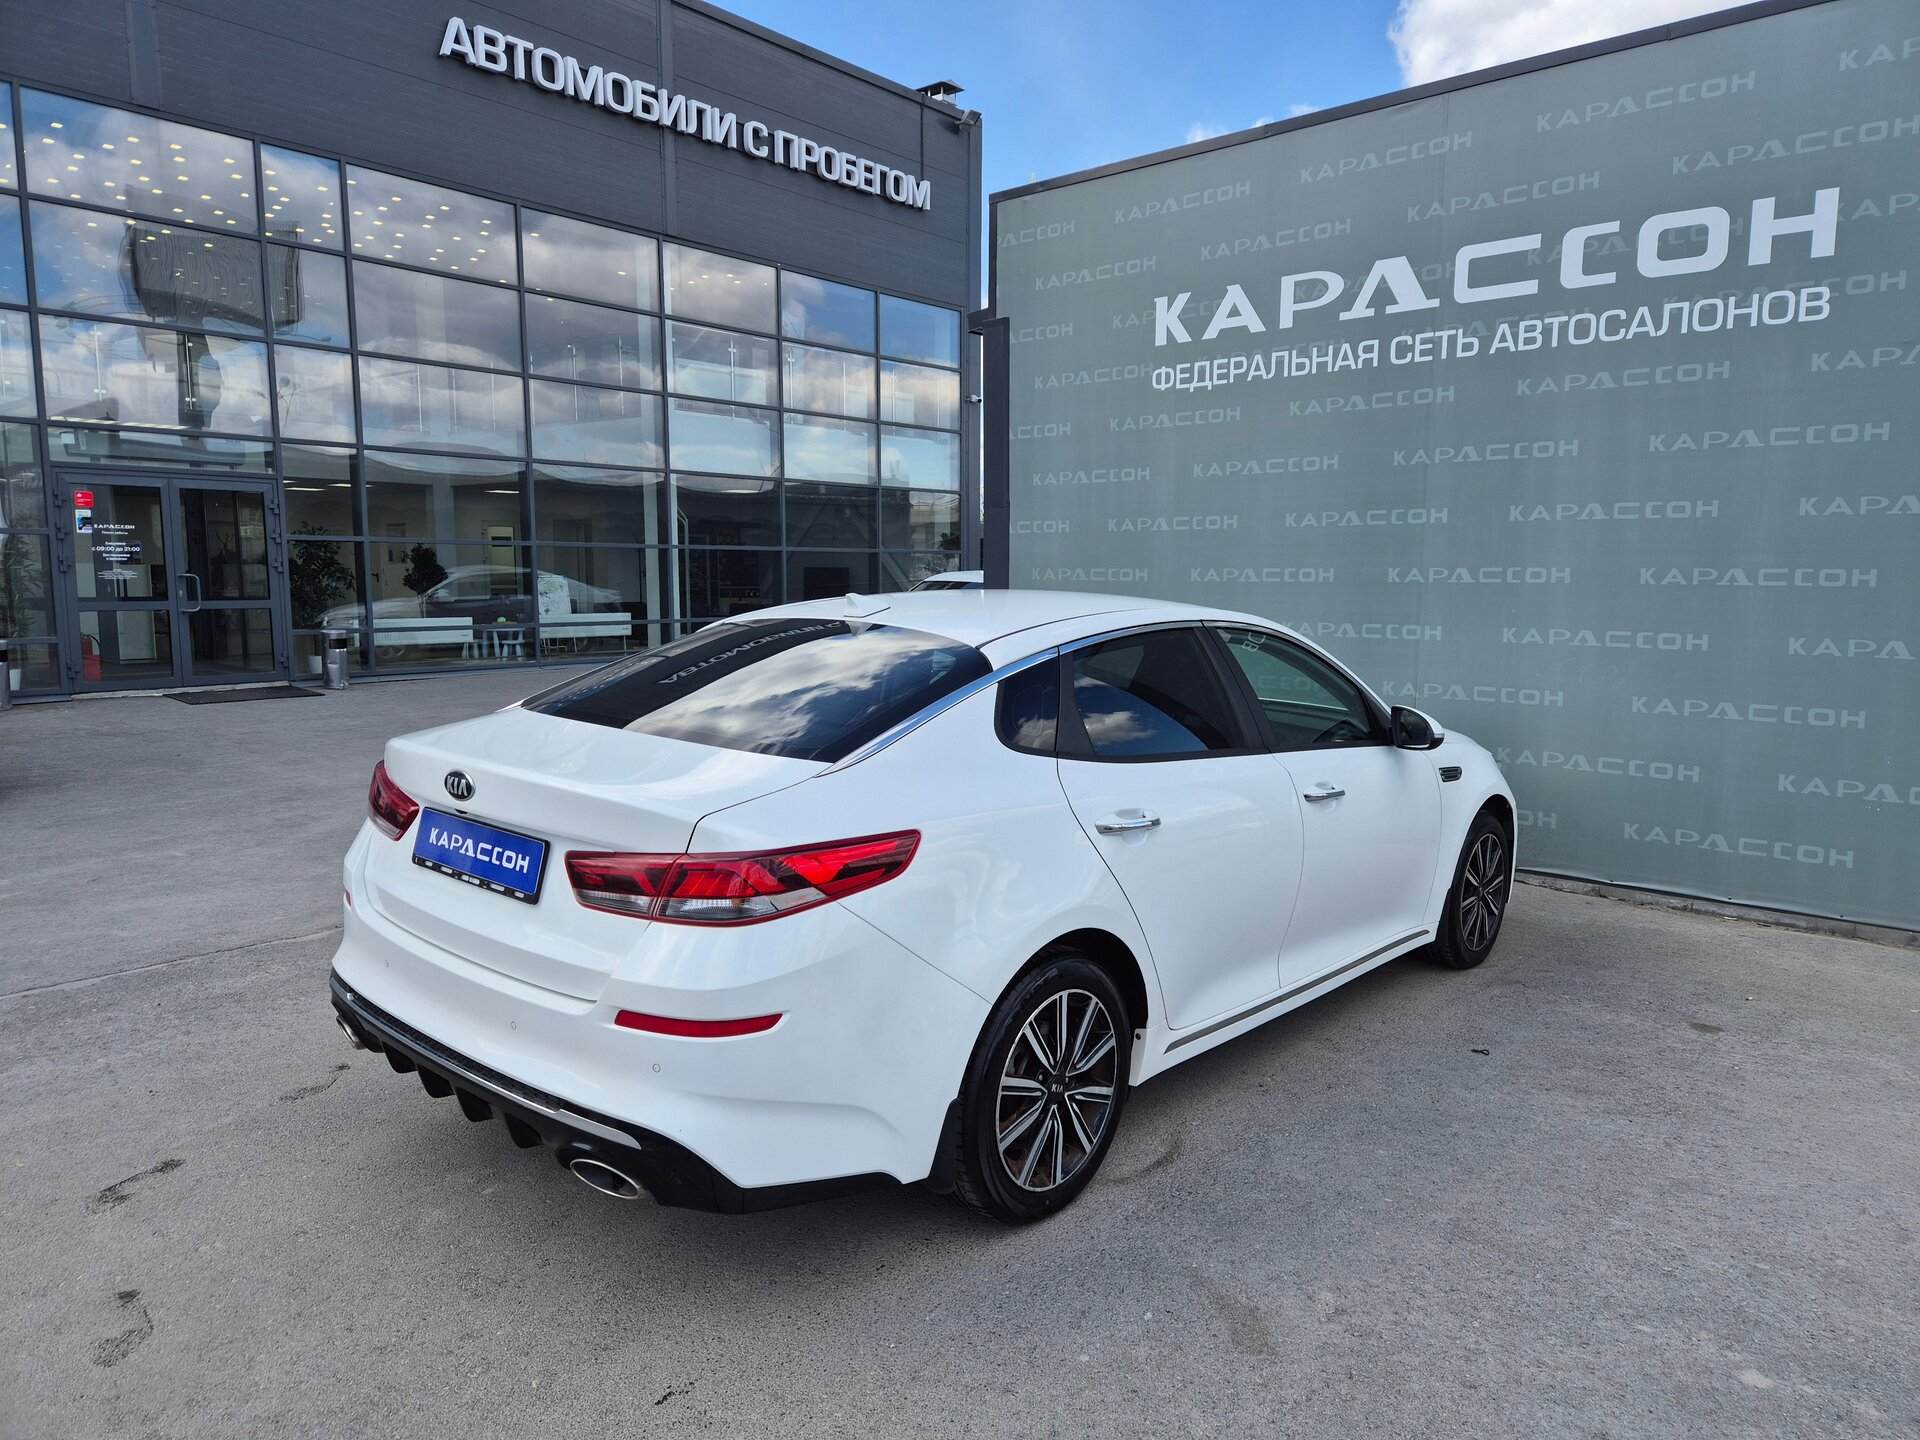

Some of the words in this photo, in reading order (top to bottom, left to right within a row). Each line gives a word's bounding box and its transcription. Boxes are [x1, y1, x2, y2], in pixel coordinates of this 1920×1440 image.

[439, 16, 737, 148] АВТОМОБИЛИ
[743, 120, 768, 158] С
[774, 129, 931, 211] ПРОБЕГОМ
[1152, 339, 1380, 392] ФЕДЕРАЛЬНАЯ
[1390, 329, 1480, 365] СЕТЬ
[1489, 286, 1831, 354] АВТОСАЛОНОВ
[447, 775, 469, 797] KIA
[1051, 1083, 1064, 1093] KIA
